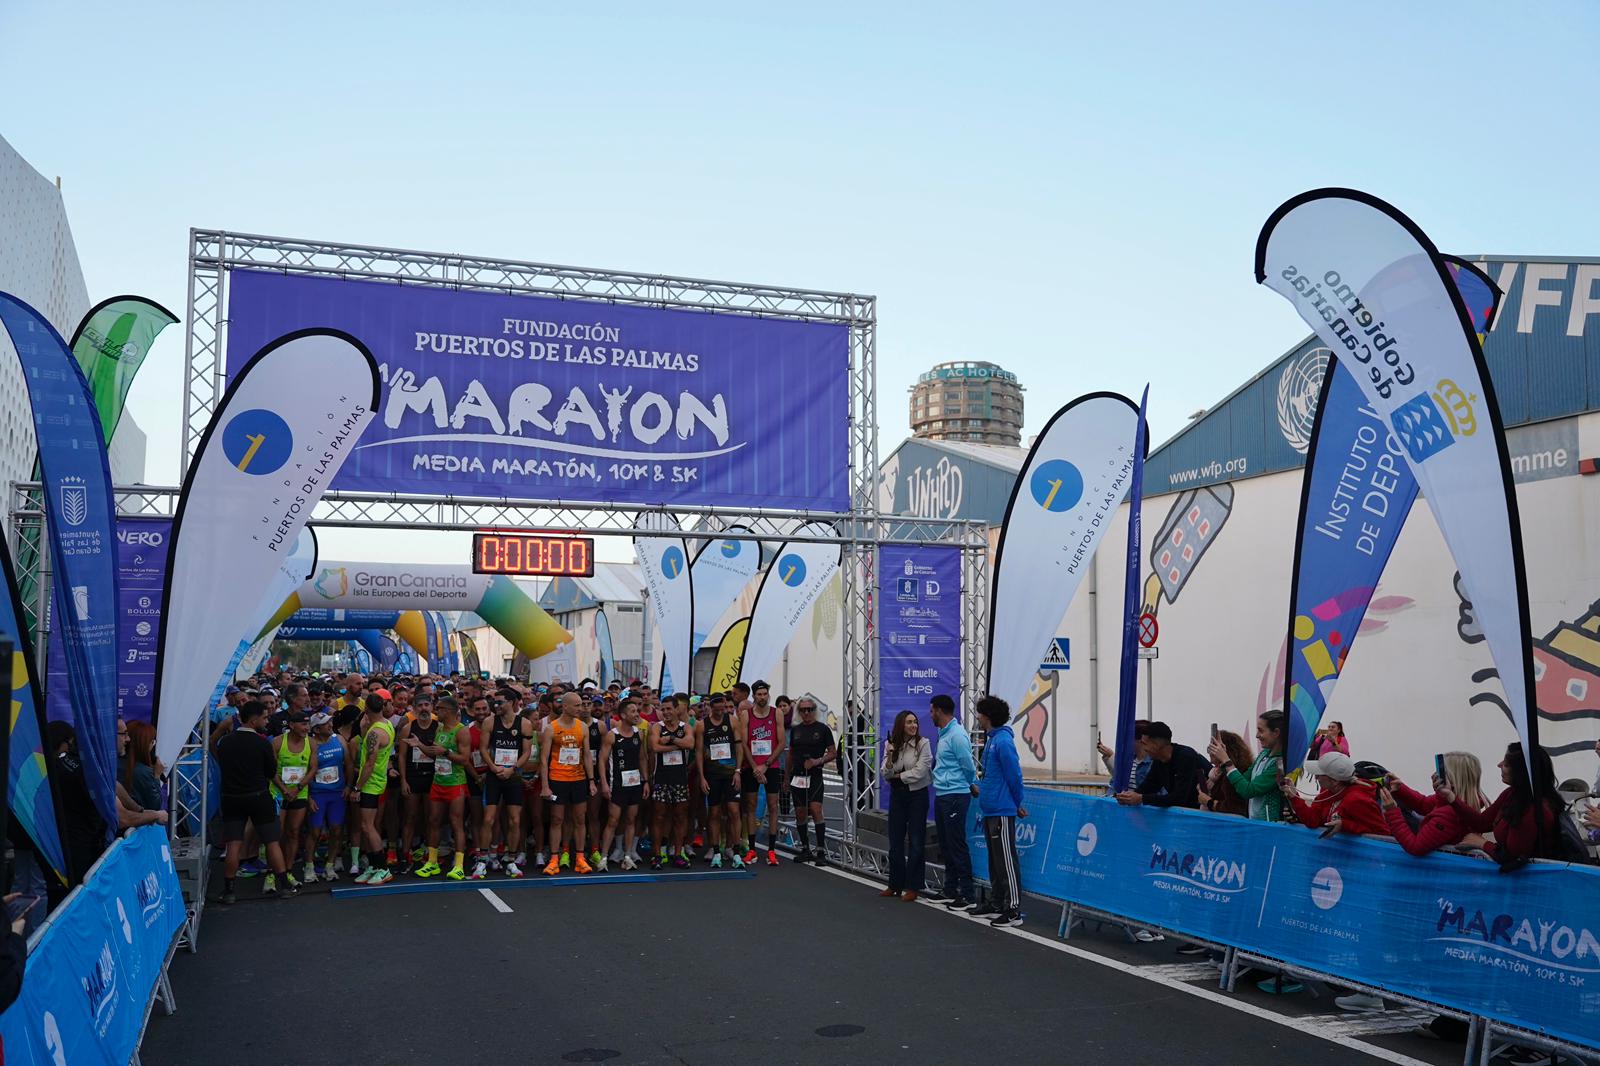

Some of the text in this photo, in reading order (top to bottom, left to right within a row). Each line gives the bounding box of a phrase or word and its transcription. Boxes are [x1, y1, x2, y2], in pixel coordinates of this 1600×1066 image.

[503, 318, 620, 343] FUNDACIÓN
[415, 332, 699, 372] PUERTOS DE LAS PALMAS
[379, 362, 420, 392] 1/2
[947, 368, 964, 377] AC
[268, 496, 305, 552] PUERTOS
[302, 476, 318, 494] DE
[319, 452, 334, 474] LAS
[331, 405, 366, 450] PALMAS
[412, 454, 698, 483] MEDIA MARATÓN, 10K & 5K
[1169, 457, 1247, 485] www.wfp.org
[907, 456, 962, 519] UNHRD
[1067, 529, 1095, 574] PUERTOS
[1091, 512, 1104, 527] DE
[1100, 492, 1115, 511] LAS
[1355, 522, 1381, 556] DE
[353, 588, 467, 599] Isla Europea del Deporte
[355, 571, 467, 588] Gran Canaria
[720, 656, 742, 689] CAJÓ
[912, 668, 938, 678] muelle
[907, 685, 933, 694] HPS
[1444, 946, 1476, 962] MEDIA
[1535, 966, 1557, 980] 10K
[1568, 975, 1585, 987] 5K
